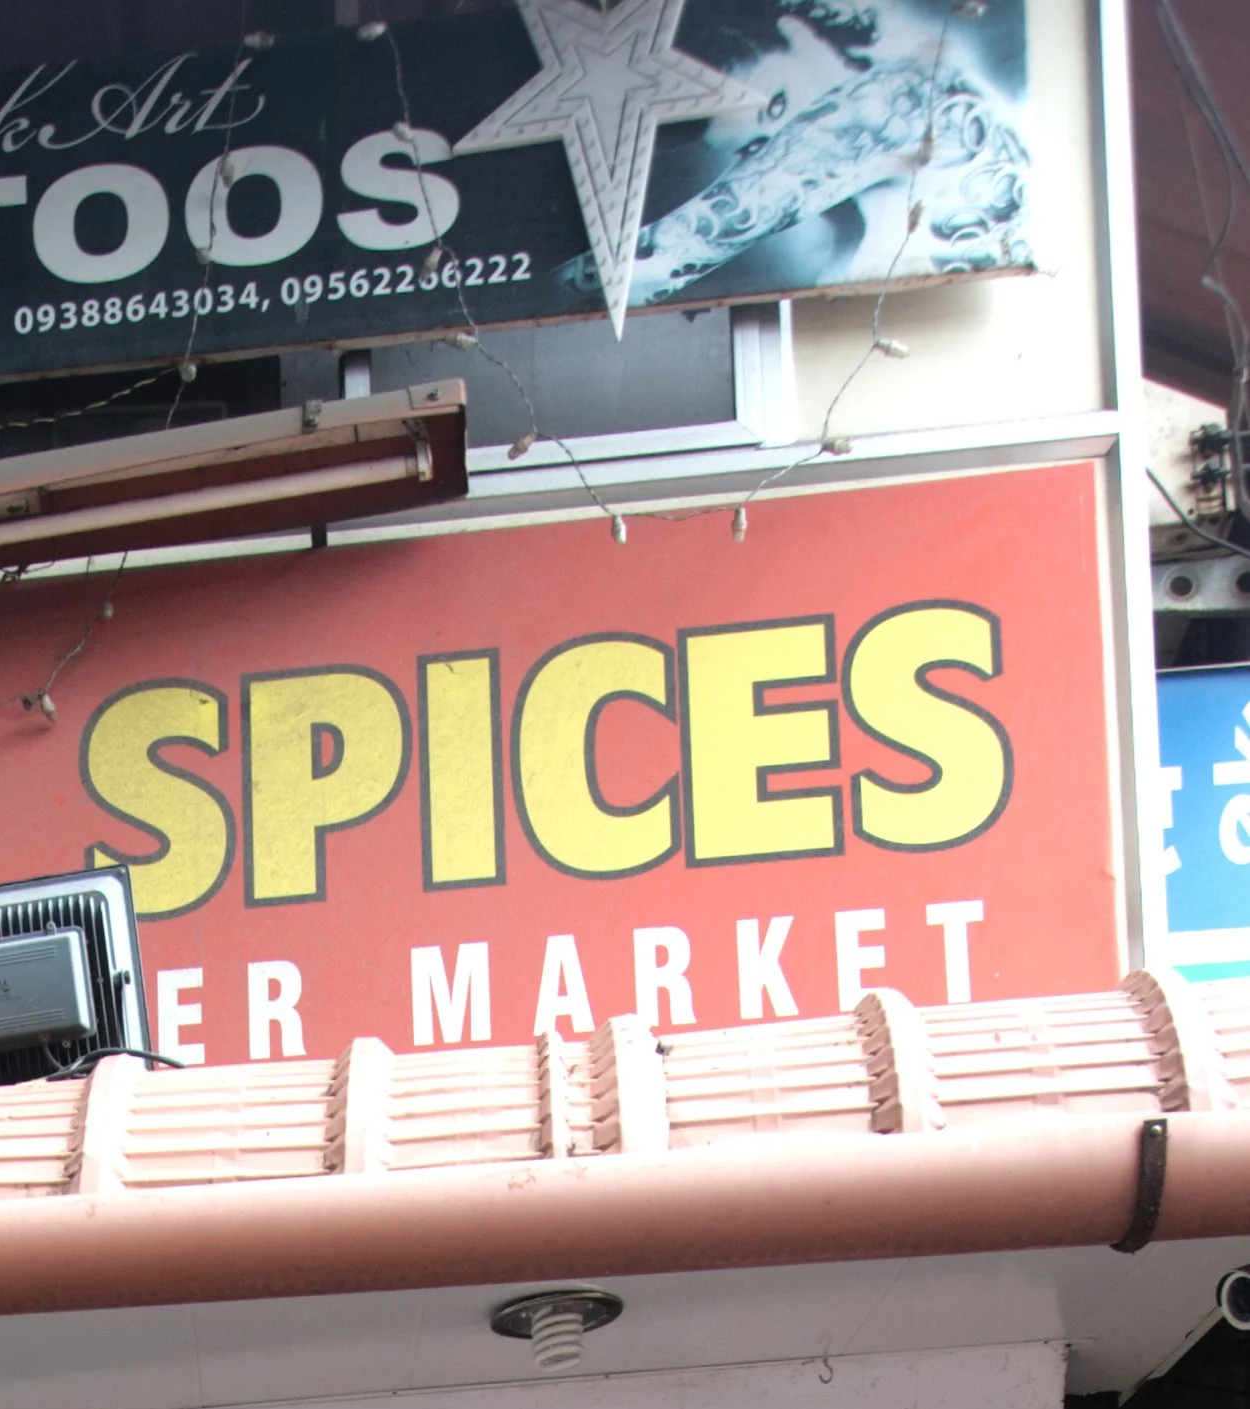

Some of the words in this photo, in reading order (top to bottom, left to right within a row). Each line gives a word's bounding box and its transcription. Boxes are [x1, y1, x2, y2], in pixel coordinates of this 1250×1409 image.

[38, 53, 266, 150] Art
[14, 282, 270, 335] 09388643034,
[79, 600, 1014, 922] SPICES
[410, 900, 984, 1046] MARKET
